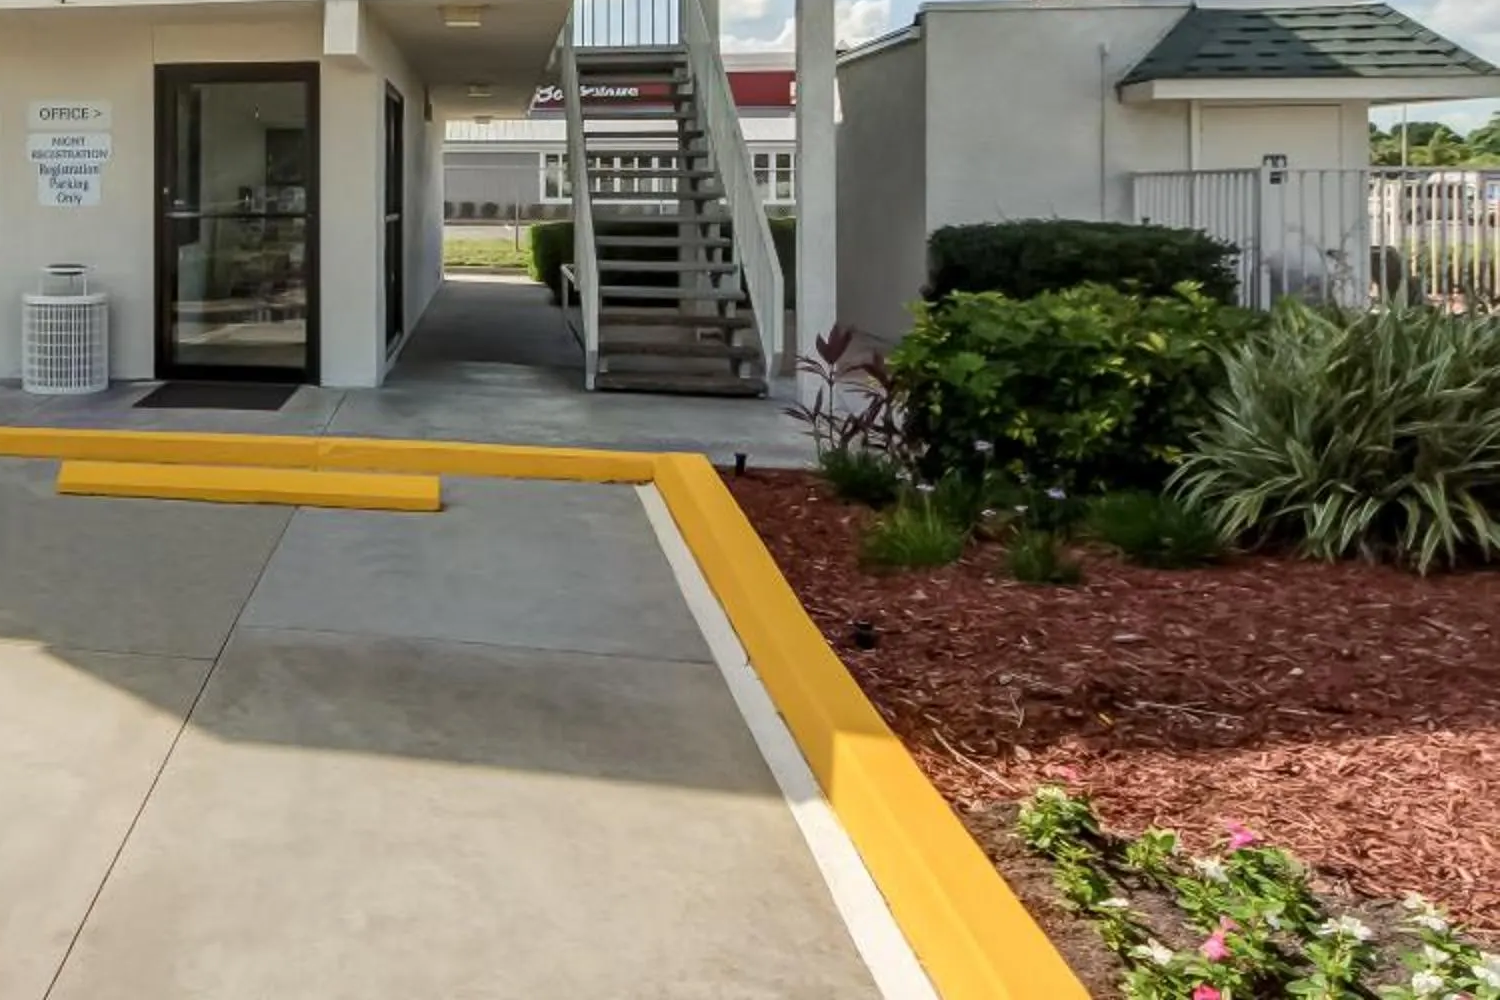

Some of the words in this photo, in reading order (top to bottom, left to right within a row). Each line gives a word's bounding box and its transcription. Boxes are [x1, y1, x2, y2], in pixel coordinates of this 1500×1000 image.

[39, 107, 89, 121] OFFICE
[51, 136, 86, 147] NIGHT
[31, 149, 109, 160] REGISTRATION
[39, 164, 100, 177] Registration
[49, 177, 90, 191] Parking
[56, 192, 83, 205] Only
